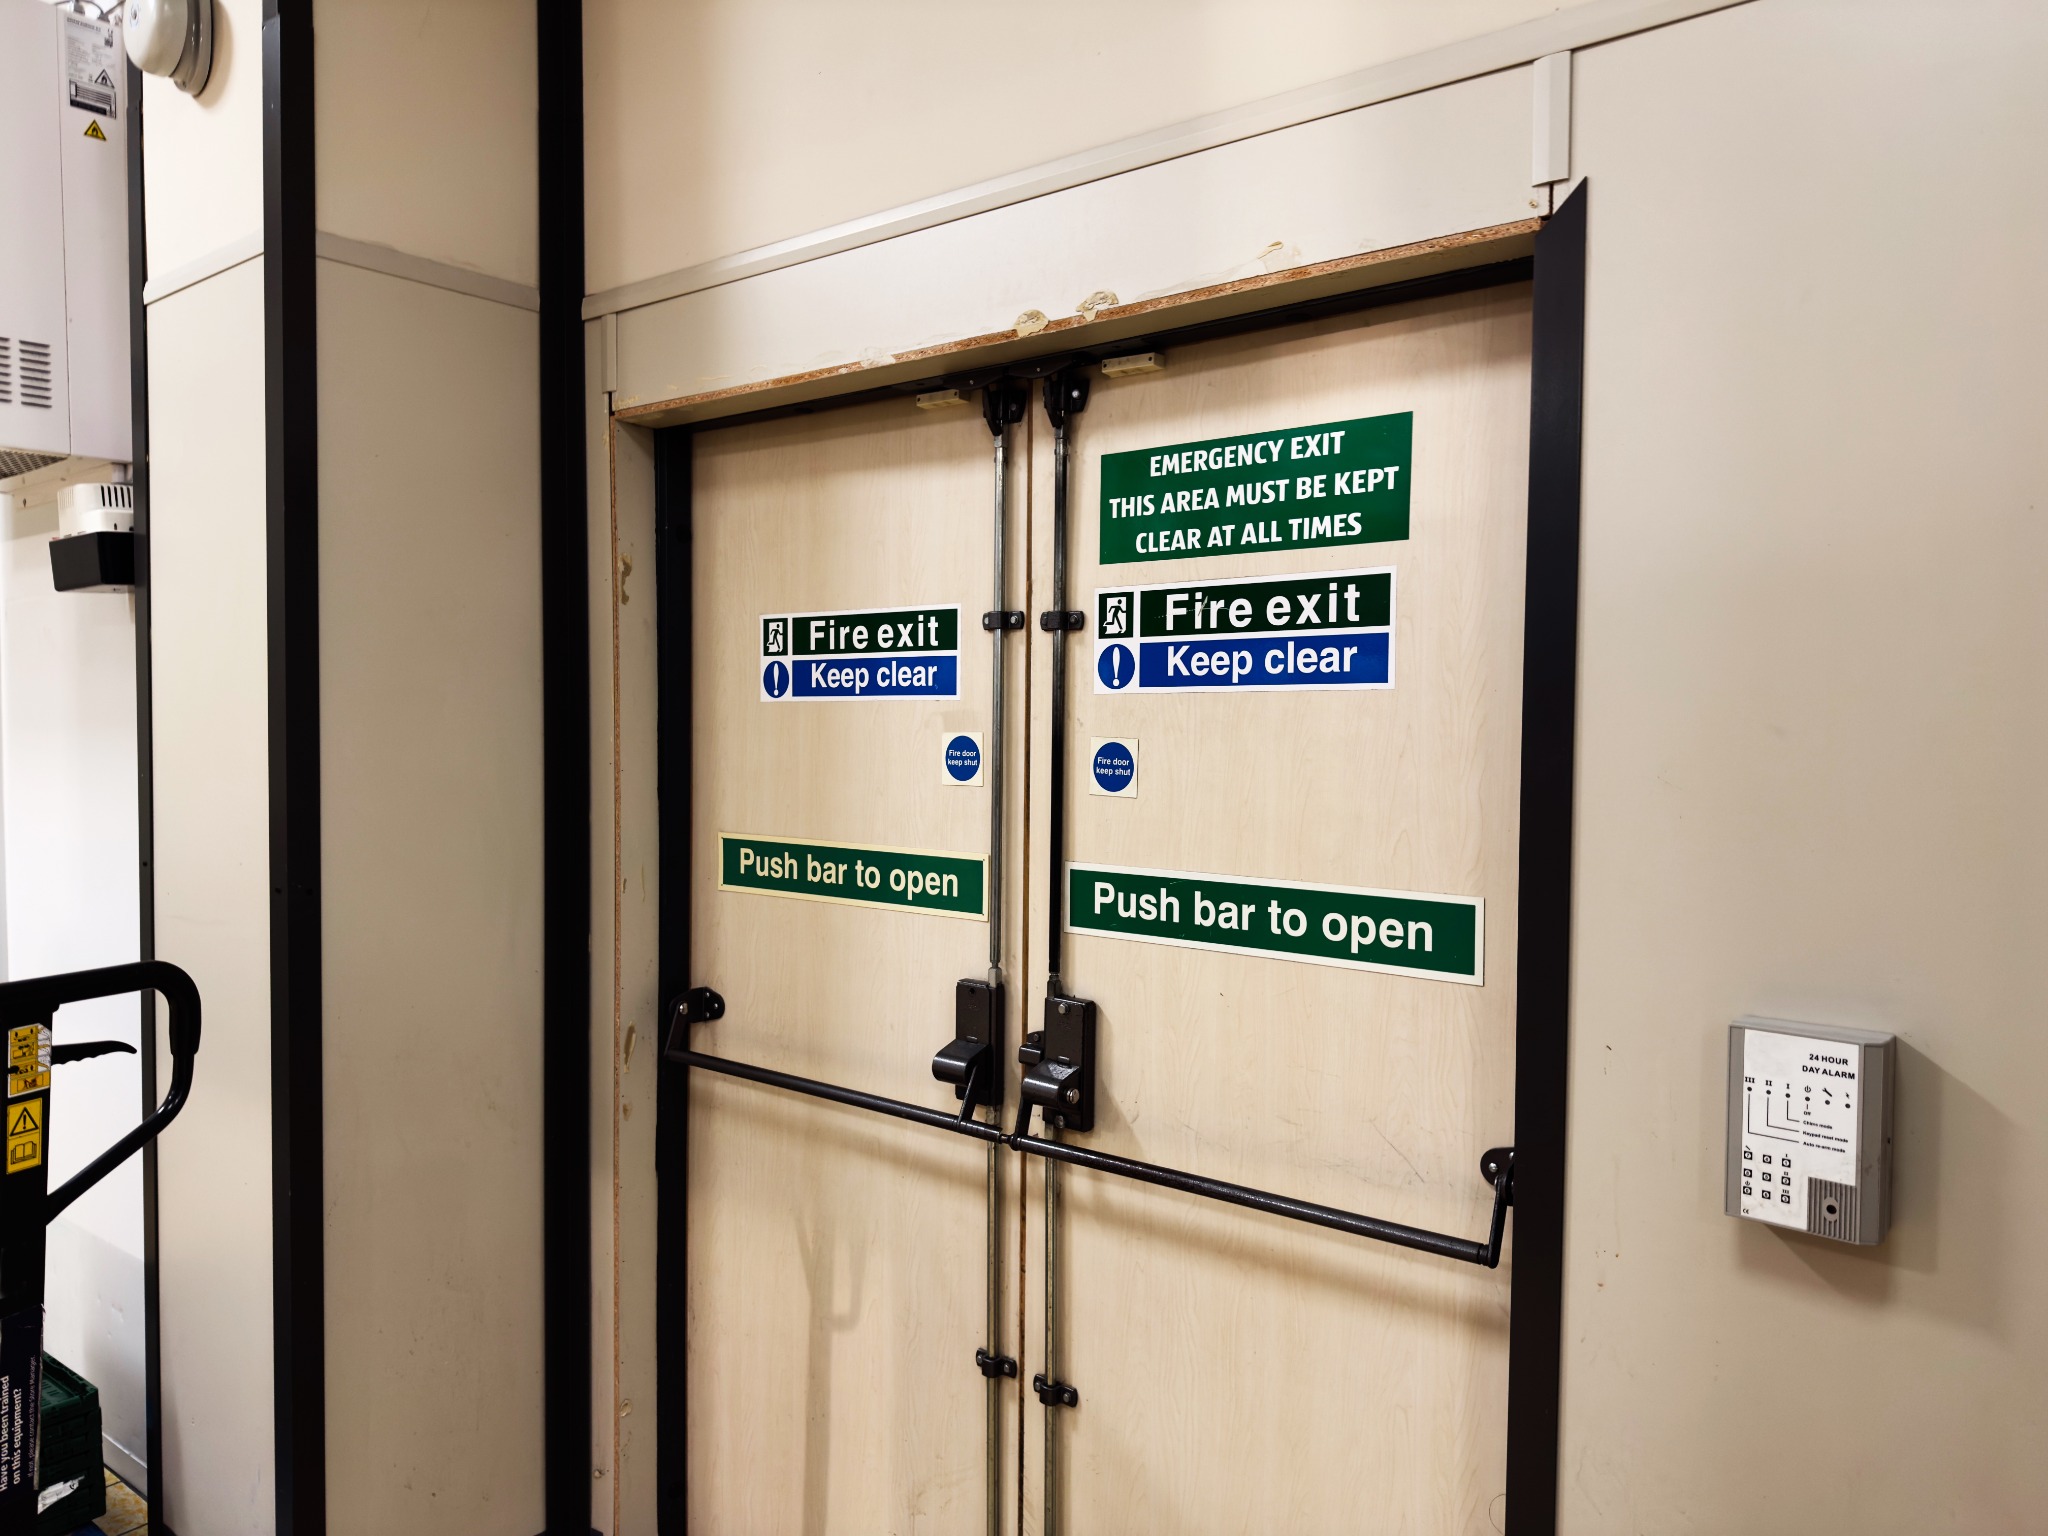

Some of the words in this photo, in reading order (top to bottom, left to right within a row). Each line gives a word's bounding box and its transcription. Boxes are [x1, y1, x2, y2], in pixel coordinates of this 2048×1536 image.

[1150, 439, 1284, 477] EMERGENCY
[1290, 430, 1345, 460] EXIT
[1109, 494, 1155, 519] THIS
[1160, 487, 1220, 515] AREA
[1225, 479, 1289, 508] MUST
[1295, 475, 1327, 500] BE
[1334, 466, 1399, 496] KEPT
[1135, 528, 1201, 554] CLEAR
[1206, 525, 1236, 548] AT
[1240, 520, 1282, 545] ALL
[1288, 512, 1362, 541] TIMES
[1165, 591, 1253, 631] Fire
[1266, 582, 1360, 625] exit
[810, 619, 869, 651] Fire
[877, 614, 939, 649] exit
[811, 662, 869, 695] Keep
[876, 660, 938, 687] clear
[1167, 645, 1253, 684] Keep
[1264, 641, 1358, 675] clear
[947, 758, 963, 767] keep
[963, 758, 978, 766] shut
[948, 749, 961, 757] Fire
[961, 749, 977, 757] door
[1097, 756, 1111, 765] Fire
[1112, 757, 1130, 766] door
[1096, 766, 1113, 776] keep
[1114, 767, 1131, 776] shut
[740, 847, 798, 881] Push
[807, 854, 848, 885] bar
[855, 860, 881, 889] to
[889, 868, 959, 901] open
[1093, 881, 1180, 923] Push
[1193, 890, 1256, 931] bar
[1268, 900, 1308, 937] to
[1322, 911, 1433, 954] open
[1802, 1065, 1820, 1074] DAY
[1821, 1068, 1856, 1080] ALARM
[1809, 1053, 1819, 1061] 24
[1821, 1055, 1849, 1066] HOUR
[0, 1375, 9, 1413] trained
[0, 1415, 9, 1441] been
[12, 1388, 23, 1448] equipment?
[1, 1443, 10, 1463] you
[11, 1450, 21, 1469] this
[0, 1464, 8, 1492] Have
[13, 1470, 20, 1485] on
